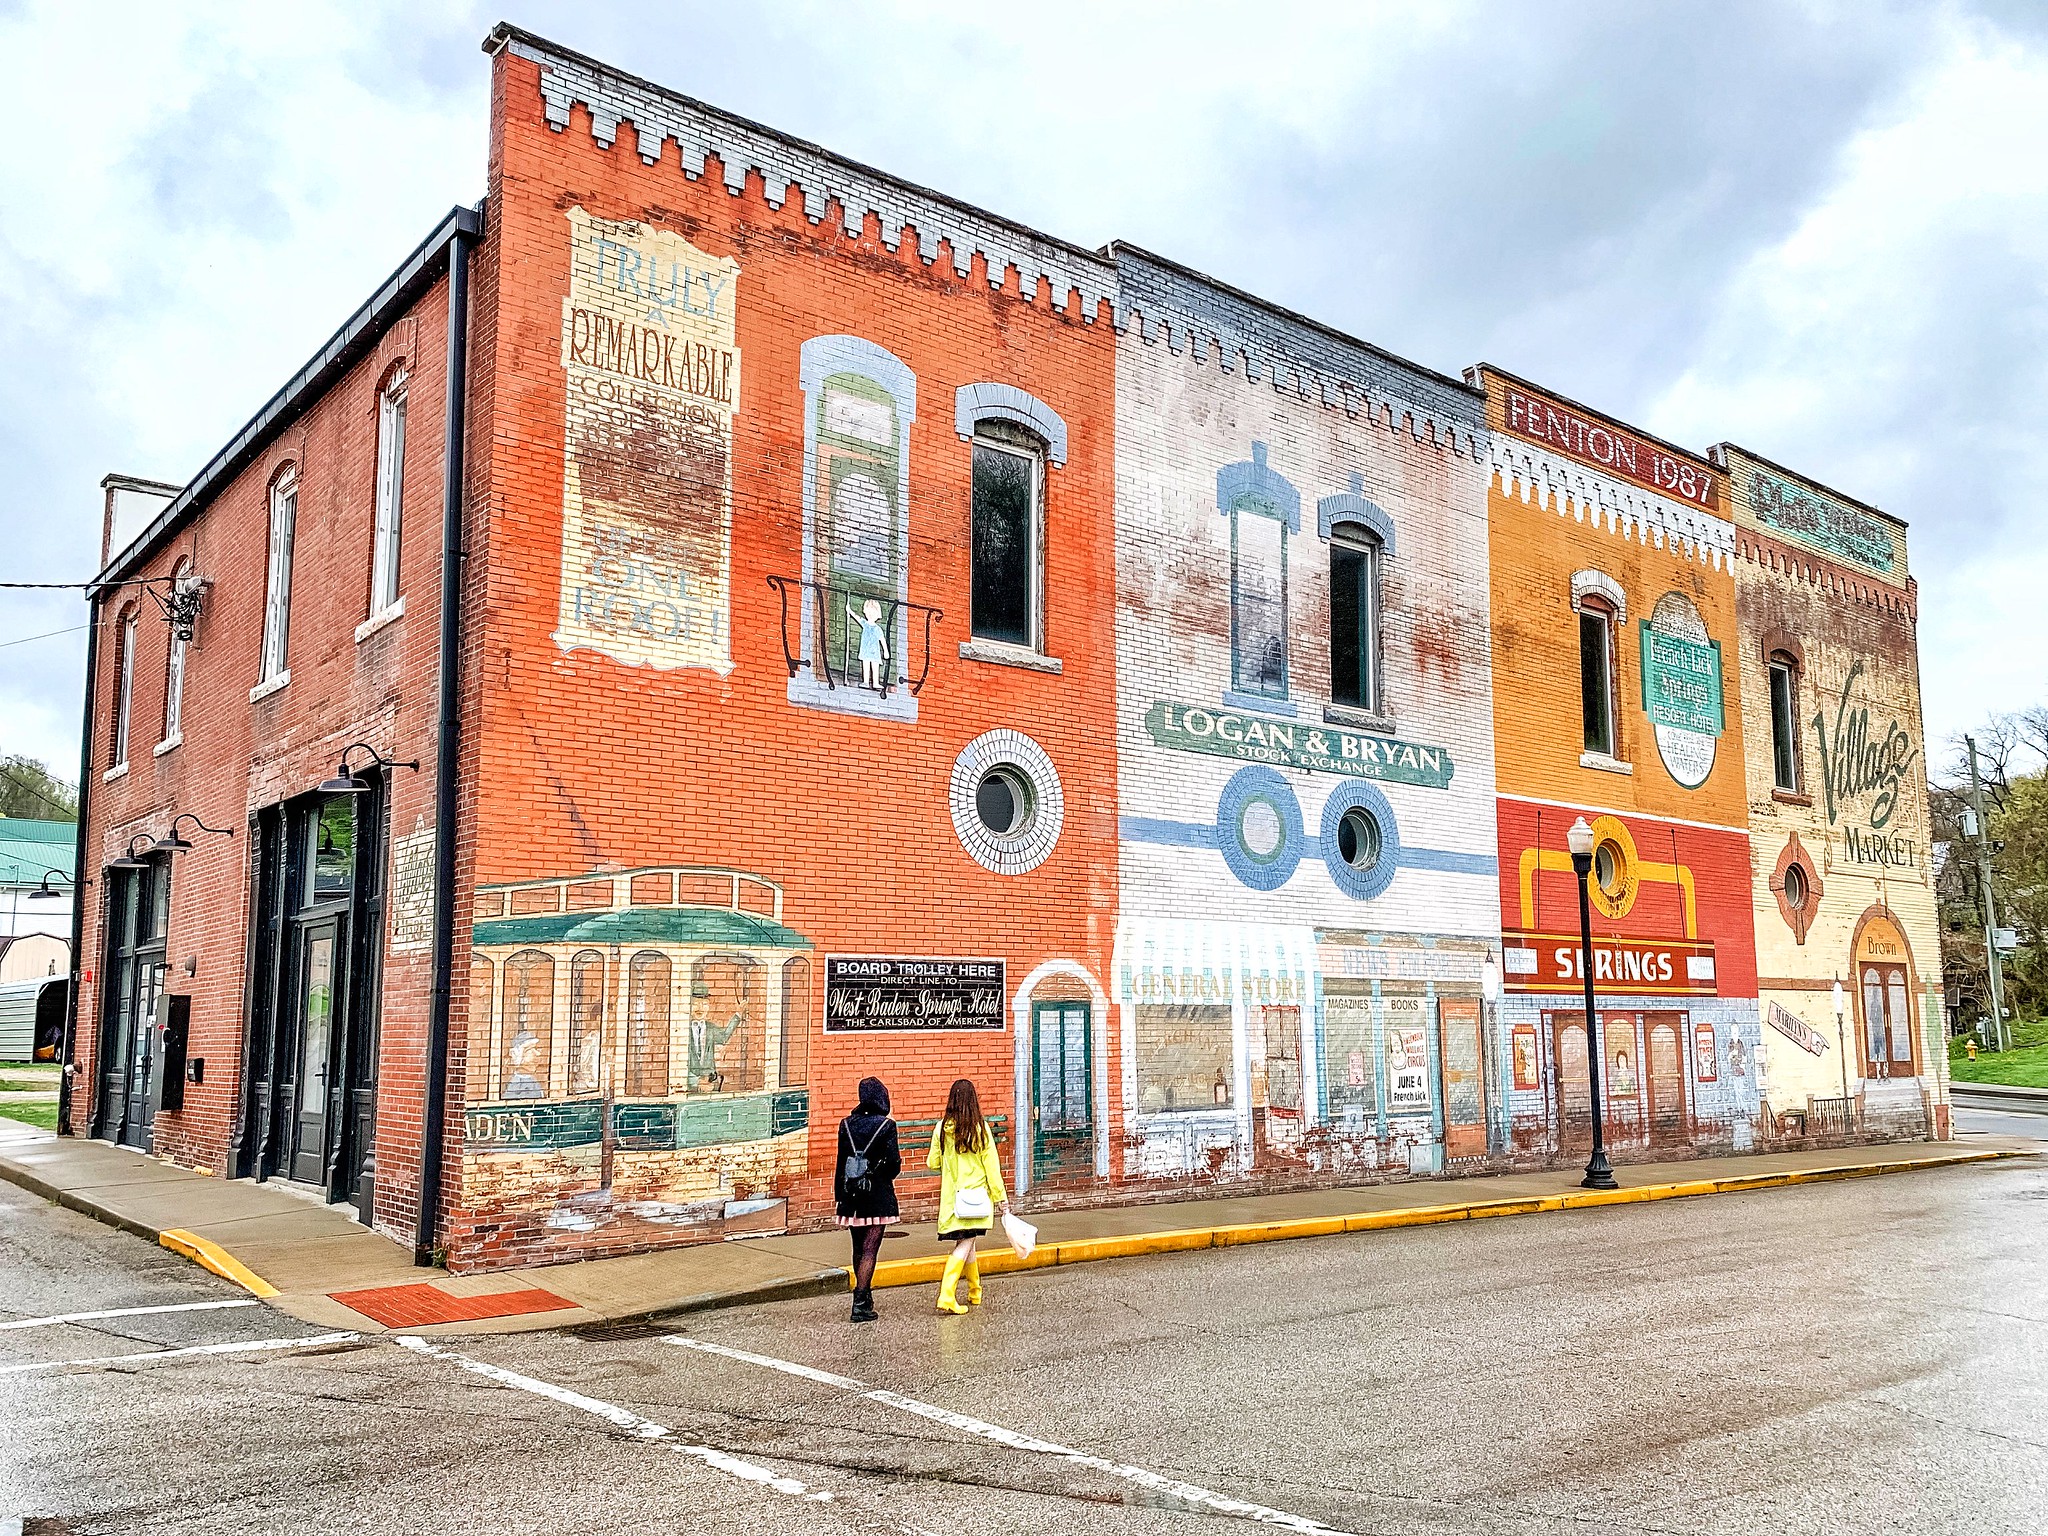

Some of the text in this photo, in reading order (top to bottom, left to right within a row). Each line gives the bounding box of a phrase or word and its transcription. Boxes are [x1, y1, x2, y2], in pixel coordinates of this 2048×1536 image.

[592, 236, 727, 320] TRULY
[645, 308, 669, 329] A
[569, 307, 733, 404] REMARKABLE
[581, 377, 721, 430] COLLECTION
[1510, 392, 1713, 503] FENTON 1987
[1650, 635, 1713, 675] French Lick
[1164, 702, 1441, 772] LOGAN & BRYAN
[1811, 660, 1920, 829] Village
[1235, 744, 1383, 777] STOCK EXCHANGE
[1843, 825, 1916, 869] MARKET
[1867, 936, 1897, 956] Brown
[836, 962, 996, 977] BOARD TROLLEY HERE
[880, 976, 958, 985] DIRECT LINE TO
[1132, 973, 1306, 1000] GENERAL STORE
[829, 987, 1002, 1024] West Baden Springs Hotel
[1328, 998, 1369, 1011] MAGAZINES
[1391, 999, 1419, 1011] BOOKS
[845, 1017, 989, 1027] THE CARLSBAD OF AMERICA
[1407, 1055, 1425, 1067] CIRCUS
[1398, 1075, 1422, 1089] JUNE 4
[1394, 1091, 1414, 1102] French
[642, 1118, 650, 1134] 1
[726, 1109, 733, 1124] 1
